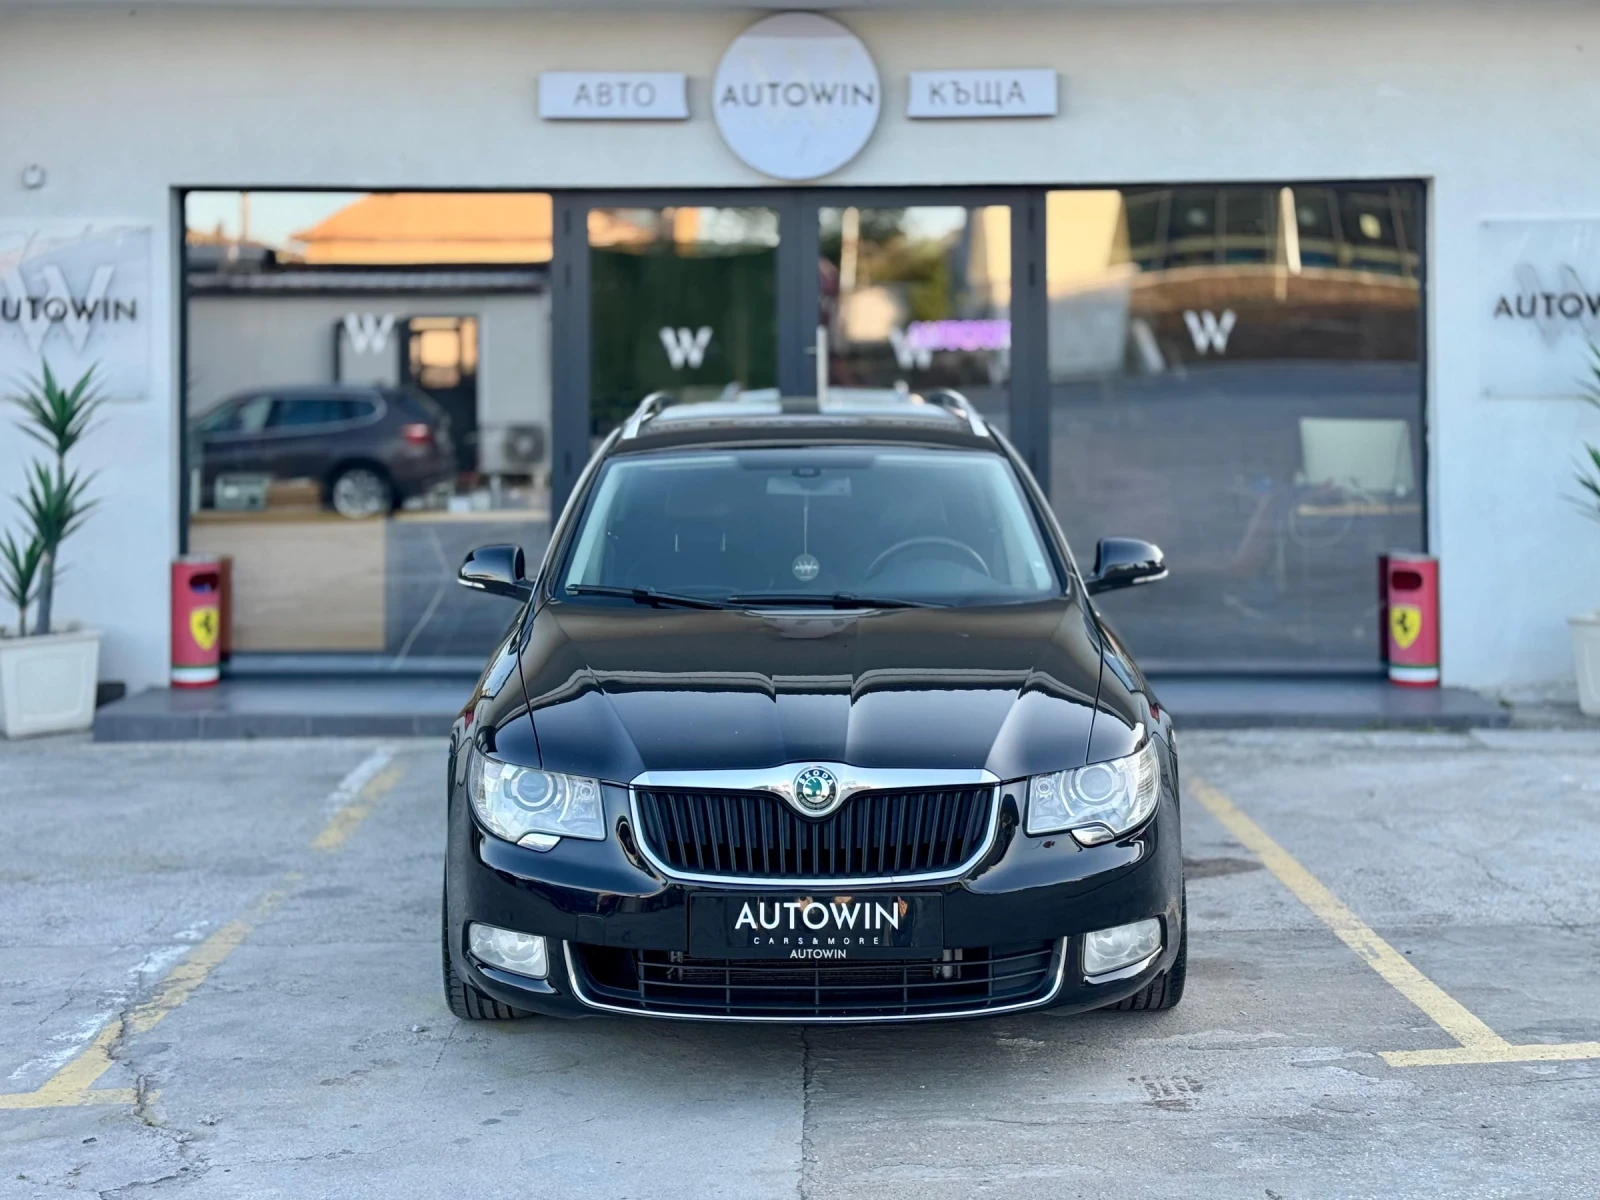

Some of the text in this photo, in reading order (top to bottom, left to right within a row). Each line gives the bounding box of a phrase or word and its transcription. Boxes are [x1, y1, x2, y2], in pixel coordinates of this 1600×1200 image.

[571, 81, 657, 108] АВТО
[721, 81, 875, 107] AUTOWIN
[927, 79, 1027, 109] КЪЩА
[0, 296, 138, 322] UTOWIN
[344, 311, 397, 355] W
[1182, 308, 1238, 356] W
[658, 326, 714, 370] W
[735, 901, 899, 930] AUTOWIN
[789, 949, 847, 959] AUTOWIN
